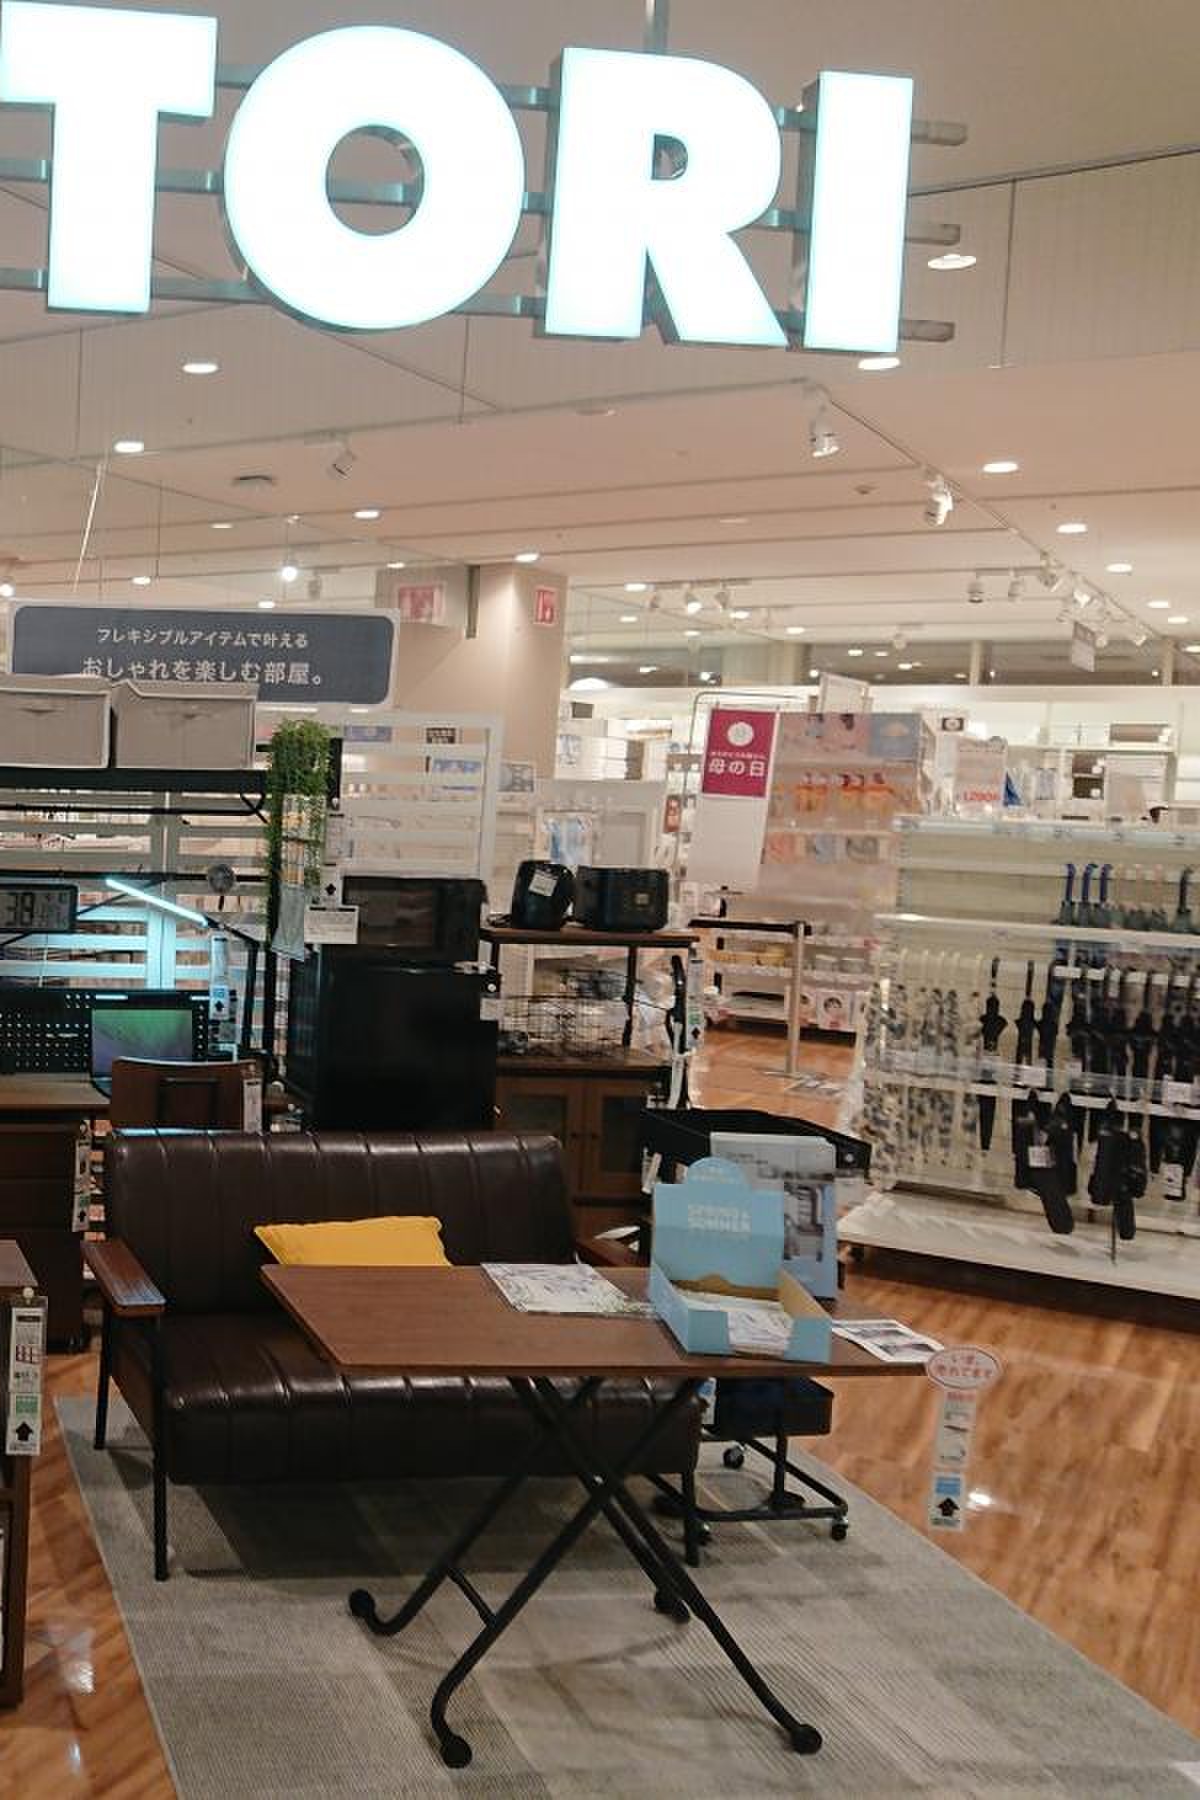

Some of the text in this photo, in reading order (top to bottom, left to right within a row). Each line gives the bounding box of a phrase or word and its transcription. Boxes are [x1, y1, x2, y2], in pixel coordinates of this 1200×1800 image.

[98, 625, 308, 648] フレキシブルアイテムで叶える
[82, 656, 322, 687] おしゃれを楽しむ部屋。
[708, 757, 765, 777] 母の日
